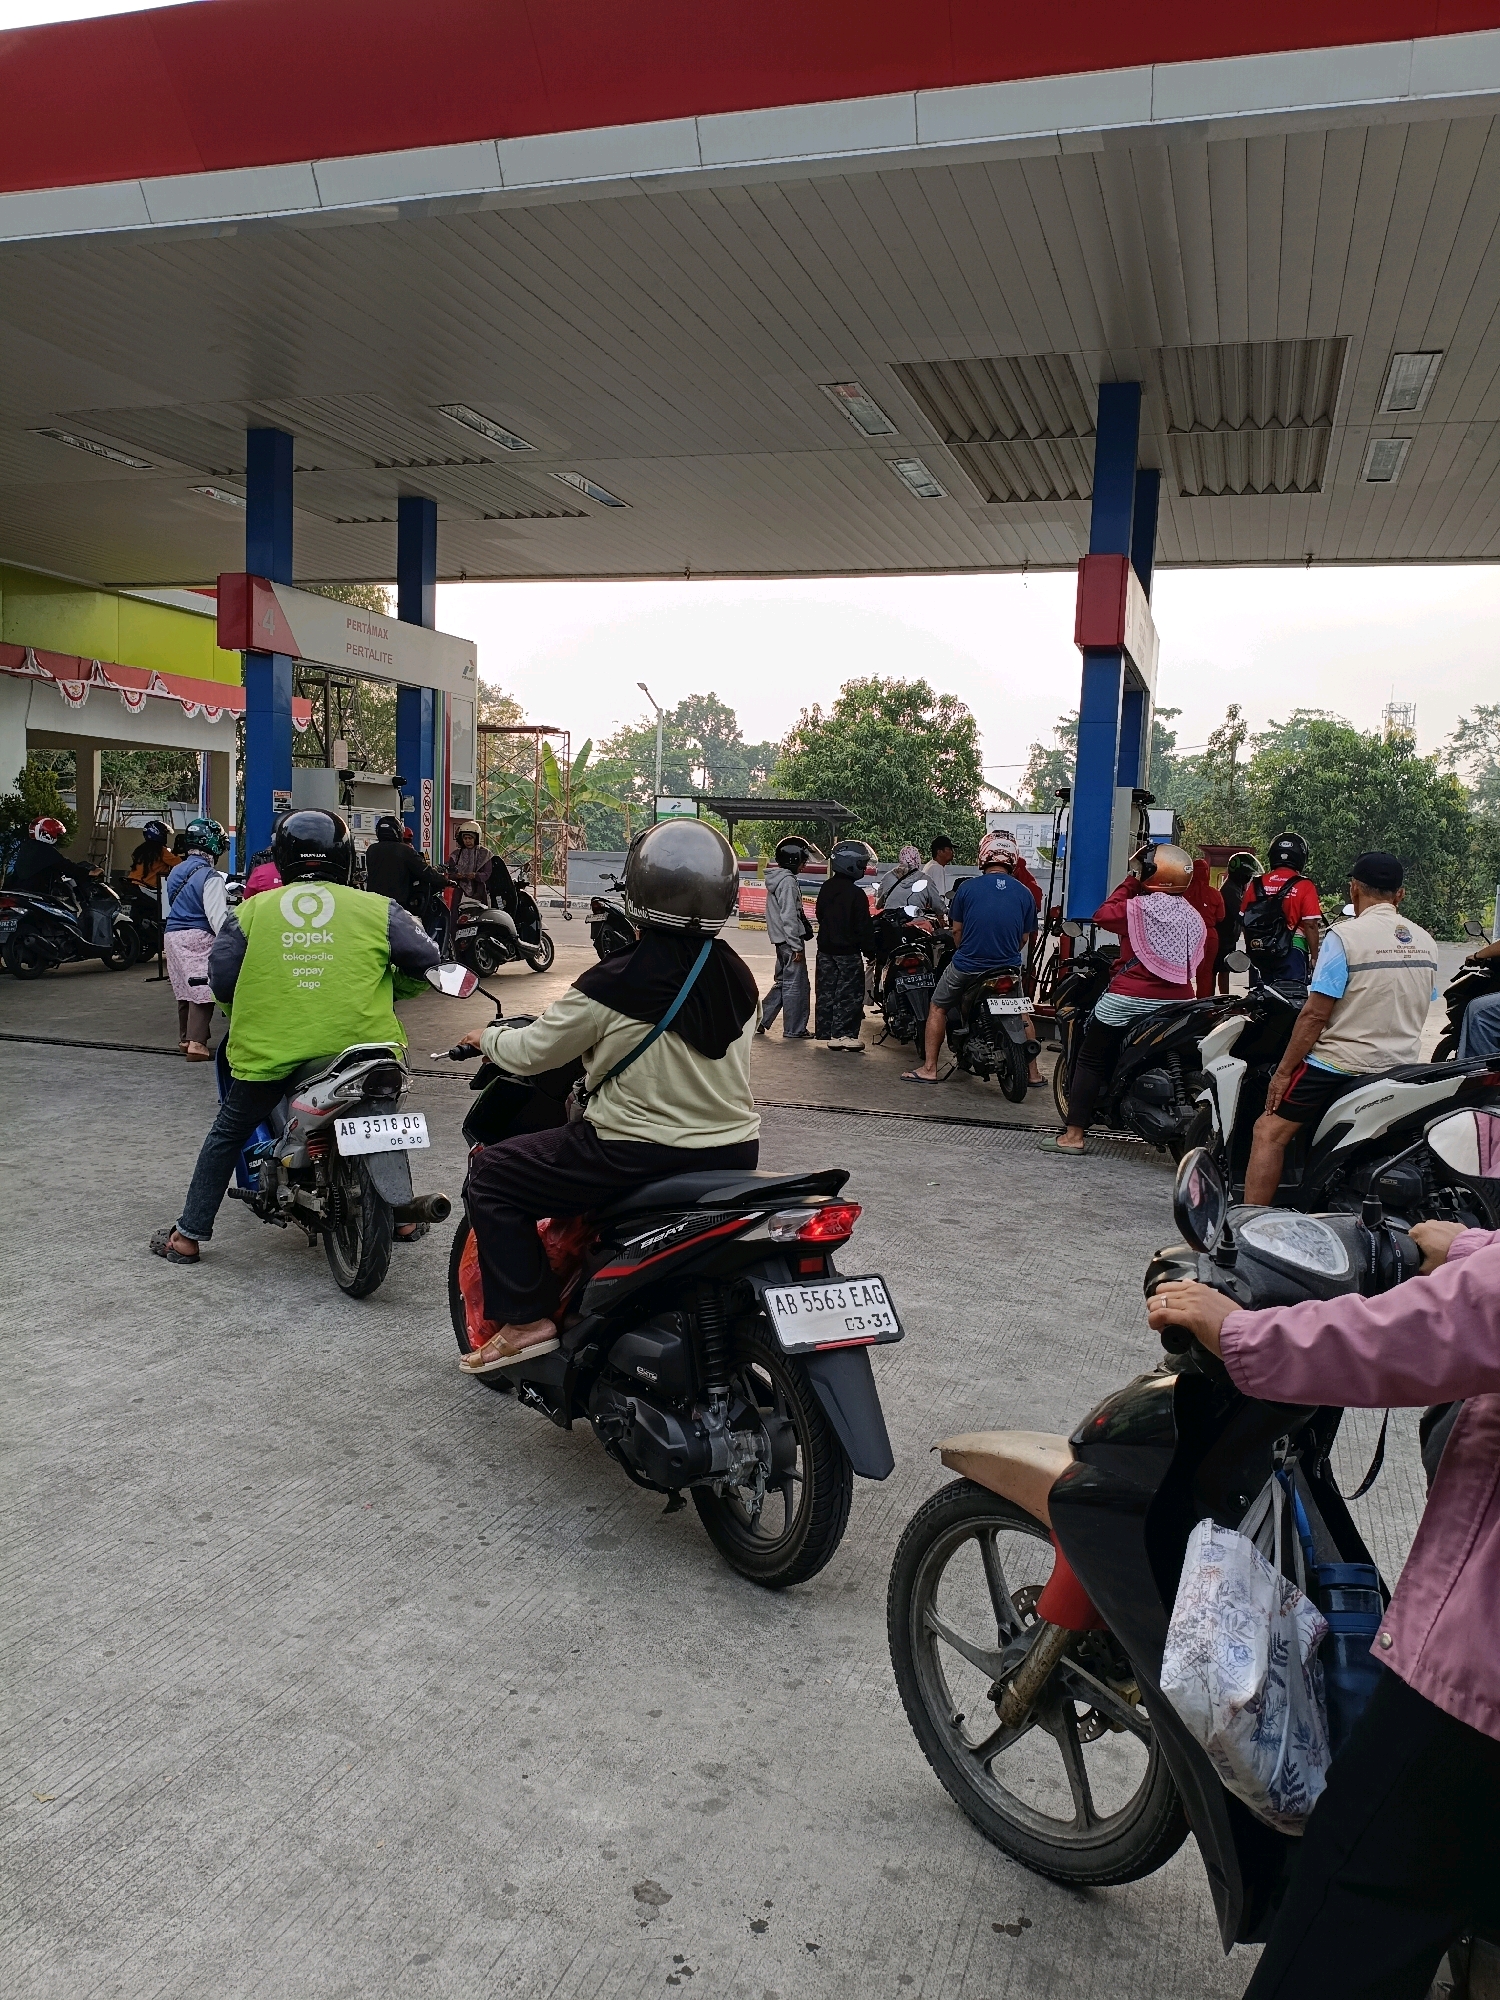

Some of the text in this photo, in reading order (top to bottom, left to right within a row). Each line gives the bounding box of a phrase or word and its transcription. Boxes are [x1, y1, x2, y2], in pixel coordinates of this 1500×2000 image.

[262, 608, 275, 636] 4
[346, 617, 389, 640] PERTAMAX
[346, 643, 393, 665] PERTALITE
[281, 929, 334, 948] gojek
[282, 953, 334, 962] tokopedia
[292, 967, 324, 976] gopay
[297, 980, 321, 989] Jago
[340, 1121, 356, 1136] AB
[363, 1117, 398, 1134] 3518
[775, 1284, 886, 1315] AB 5563 EAG
